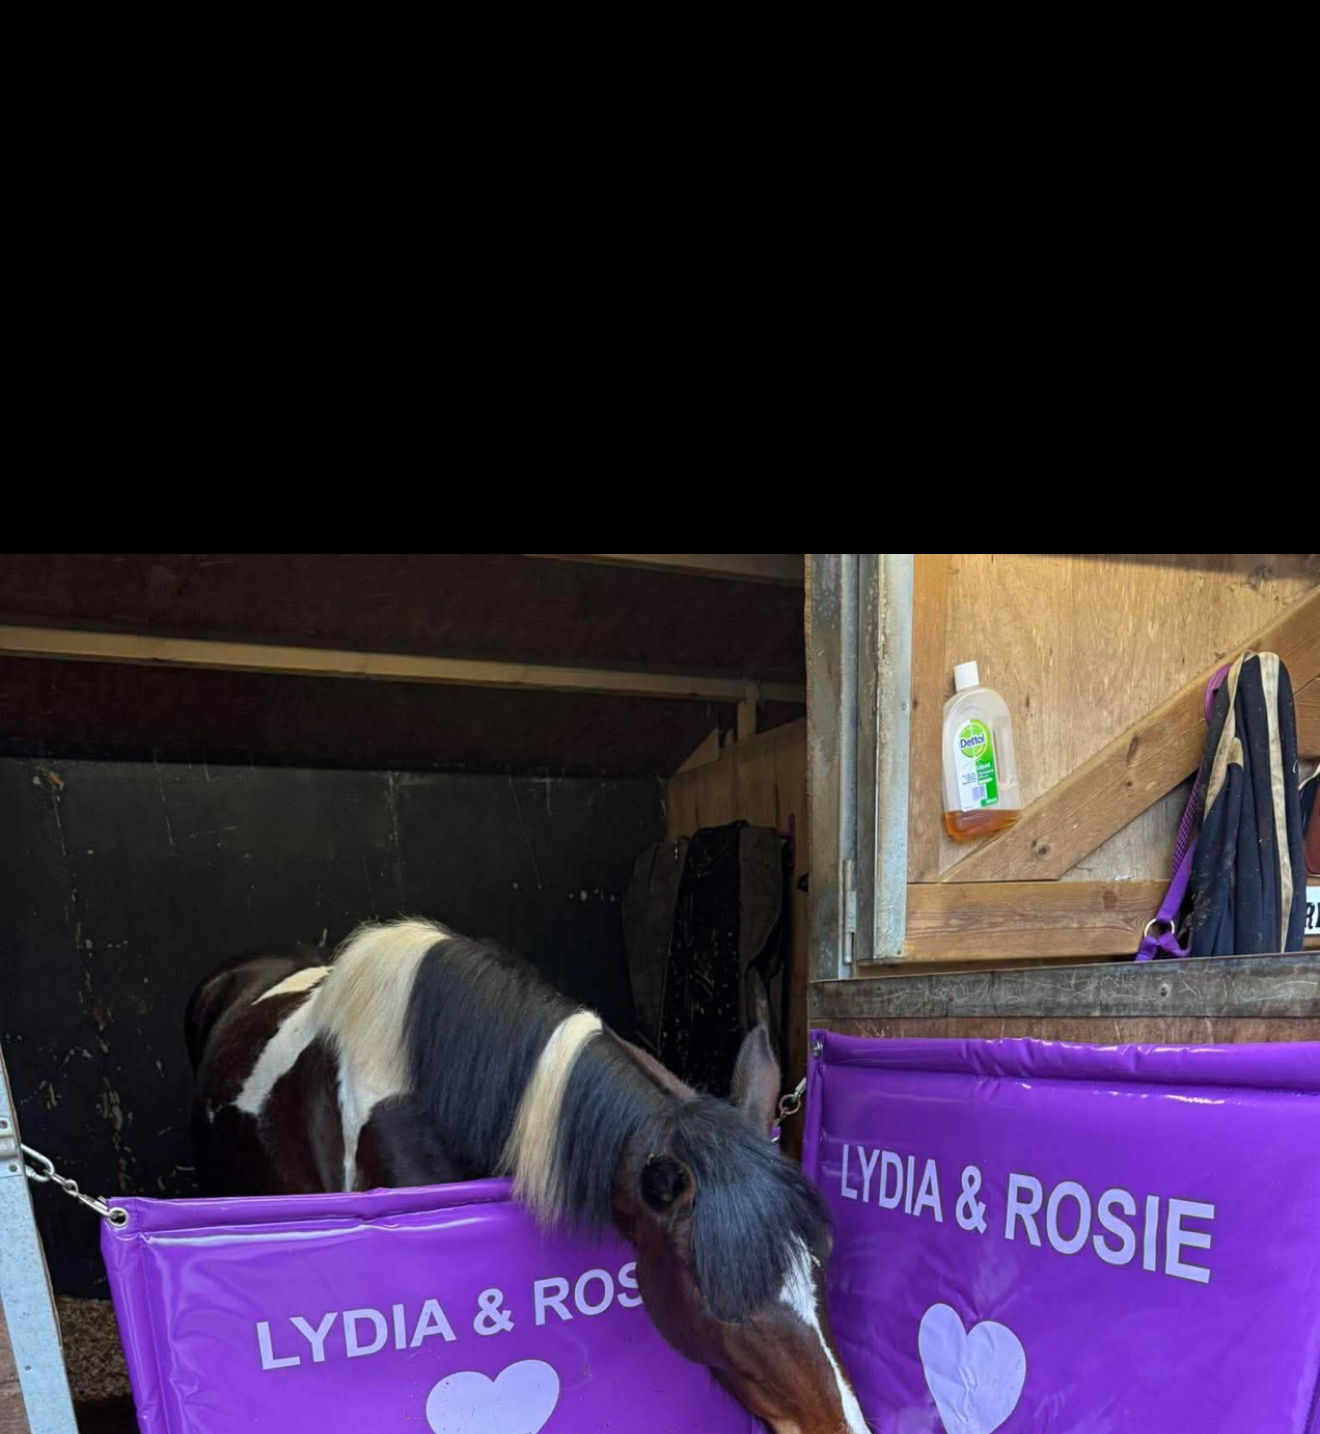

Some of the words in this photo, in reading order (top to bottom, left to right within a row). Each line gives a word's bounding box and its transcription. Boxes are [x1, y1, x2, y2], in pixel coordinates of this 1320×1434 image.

[960, 734, 985, 748] Dettol
[841, 1144, 943, 1223] LYDIA
[955, 1165, 988, 1234] &
[1004, 1173, 1216, 1284] ROSIE
[256, 1298, 457, 1371] LYDIA
[472, 1288, 515, 1337] &
